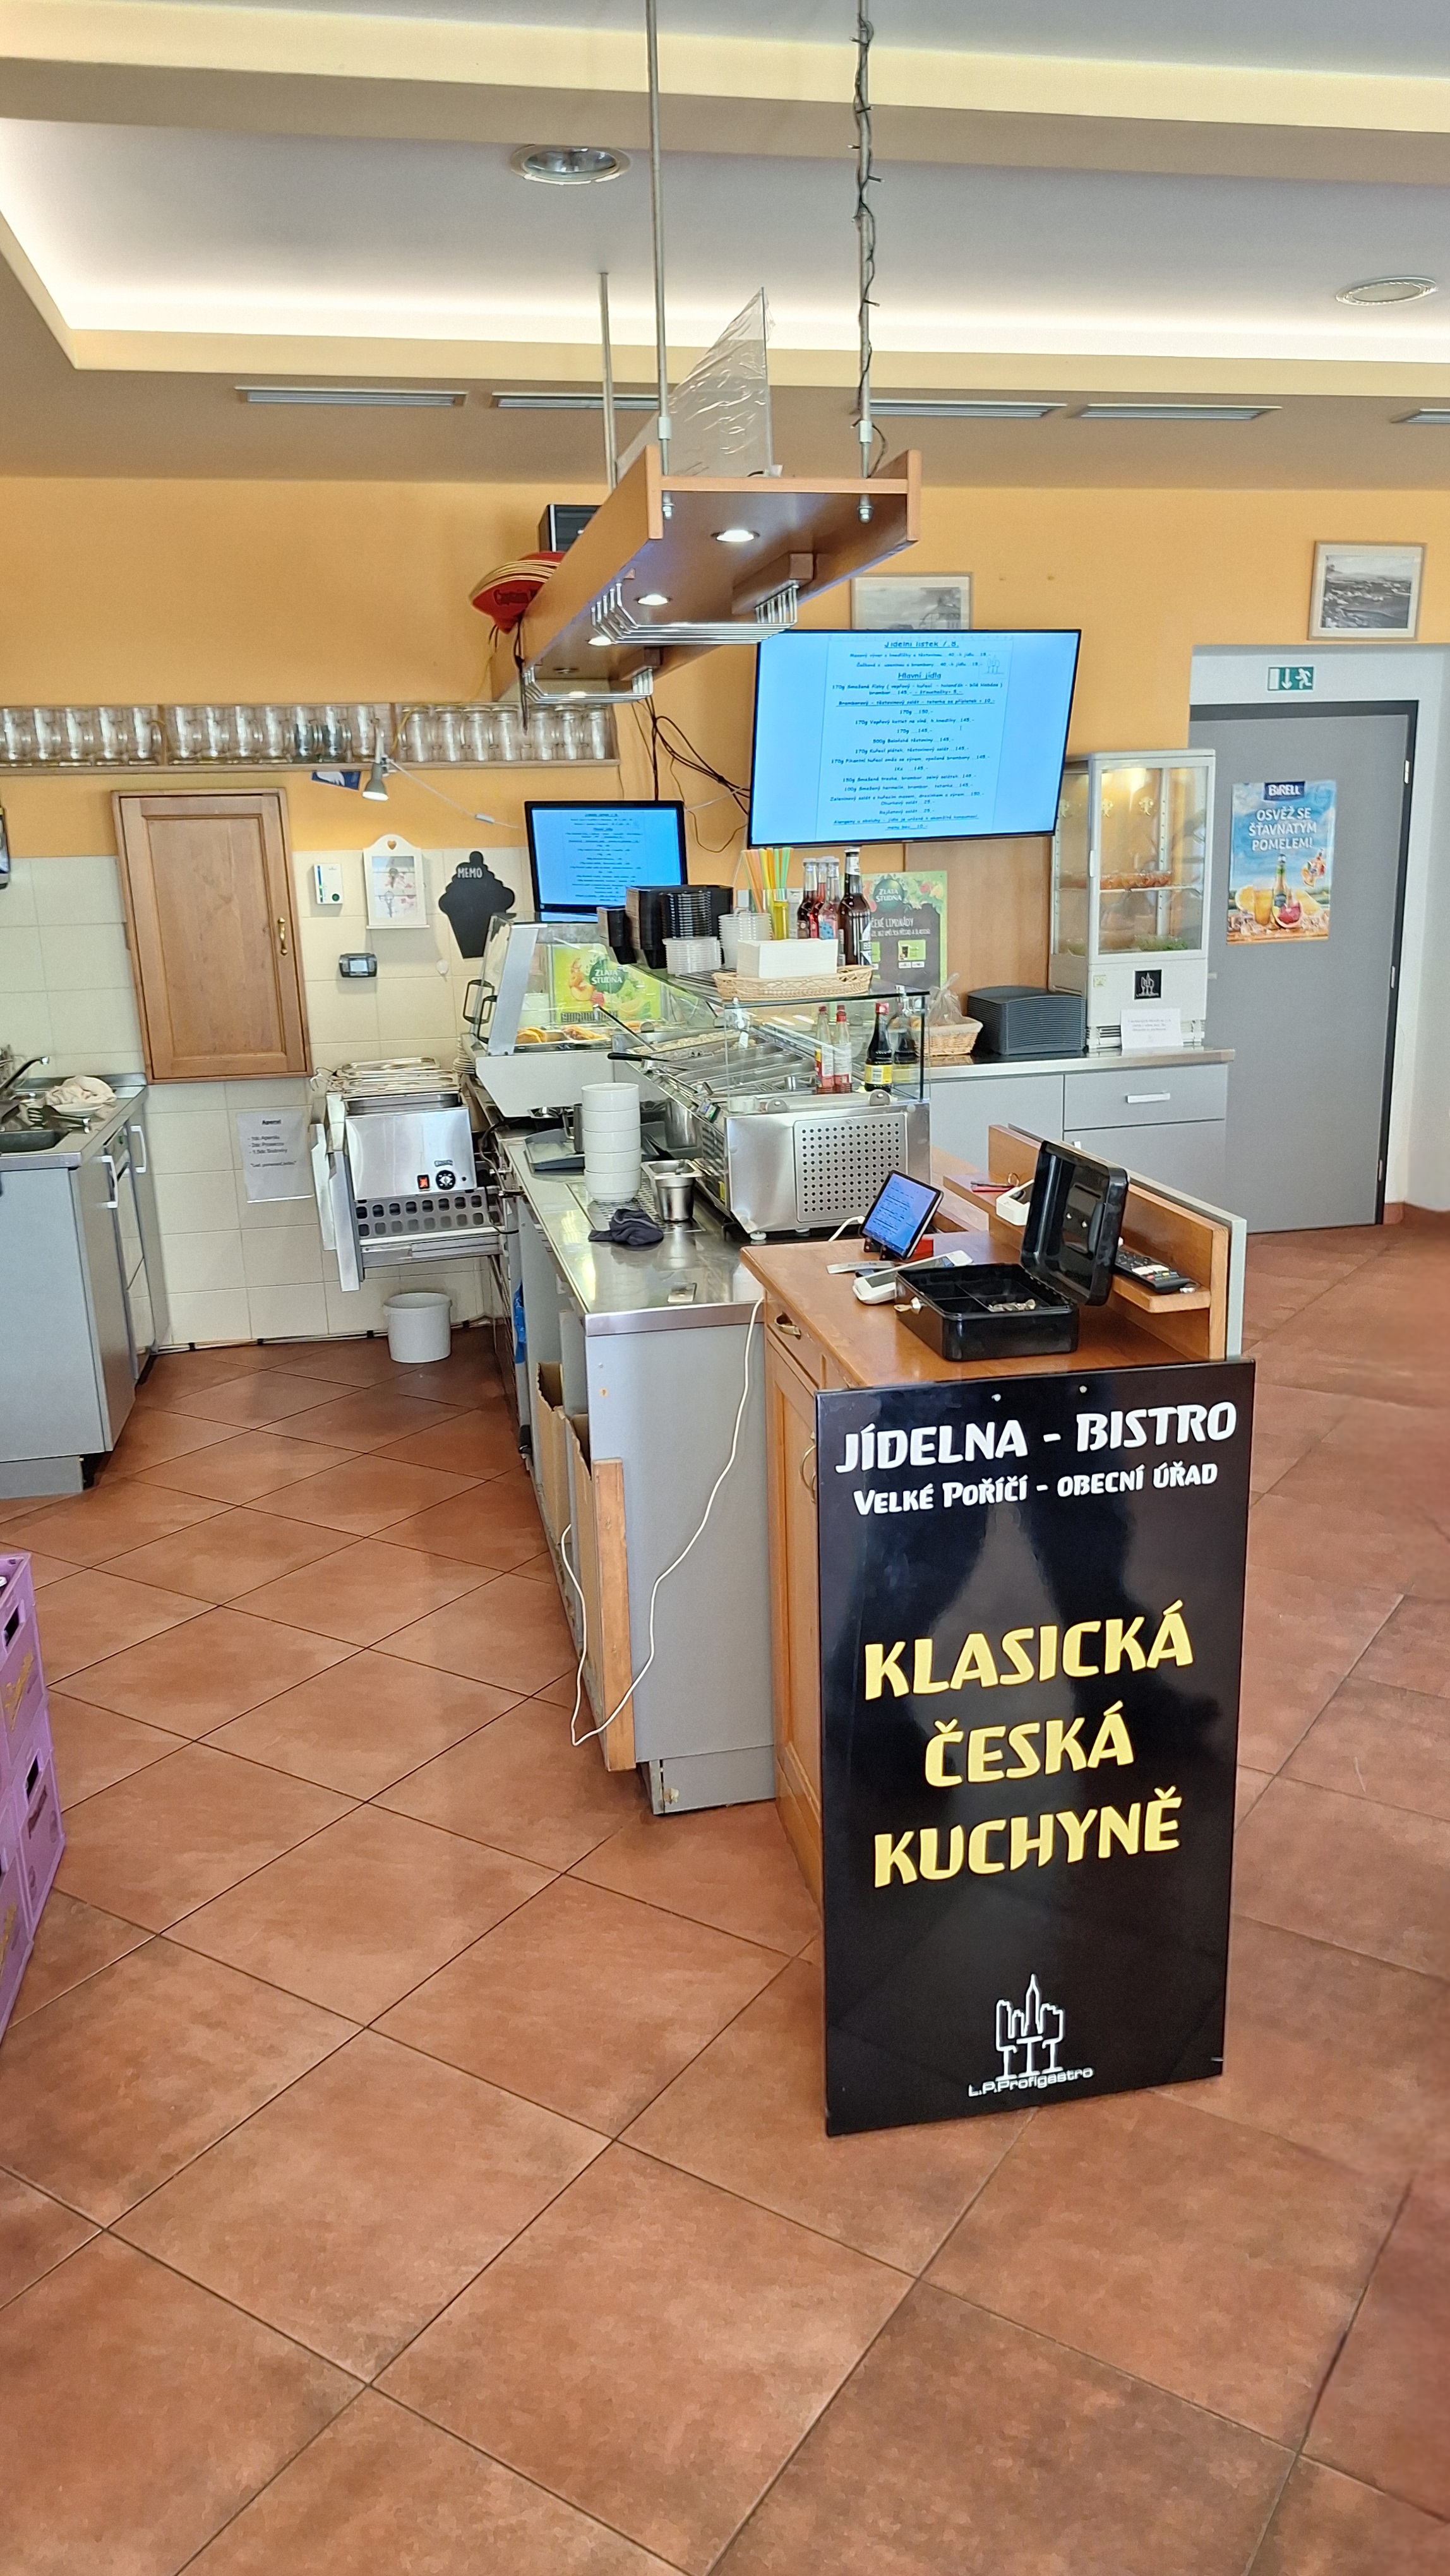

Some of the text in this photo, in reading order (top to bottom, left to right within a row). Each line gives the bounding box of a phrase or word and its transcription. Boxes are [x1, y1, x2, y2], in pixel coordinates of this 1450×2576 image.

[898, 671, 921, 679] Hlavní
[1256, 805, 1312, 821] OSVĚŽ SE
[1252, 837, 1314, 852] POMELEM!
[457, 867, 483, 879] MEMO
[875, 894, 902, 903] STUDNA
[591, 976, 623, 984] STUDNA
[836, 1402, 1237, 1474] JÍDELNA - BISTRO
[1057, 1464, 1145, 1498] OBECNÍ
[1153, 1460, 1218, 1488] ÚŘAD
[865, 1599, 1194, 1701] KLASICKÁ
[925, 1700, 1134, 1787] ČESKÁ
[874, 1786, 1182, 1889] KUCHYNĚ
